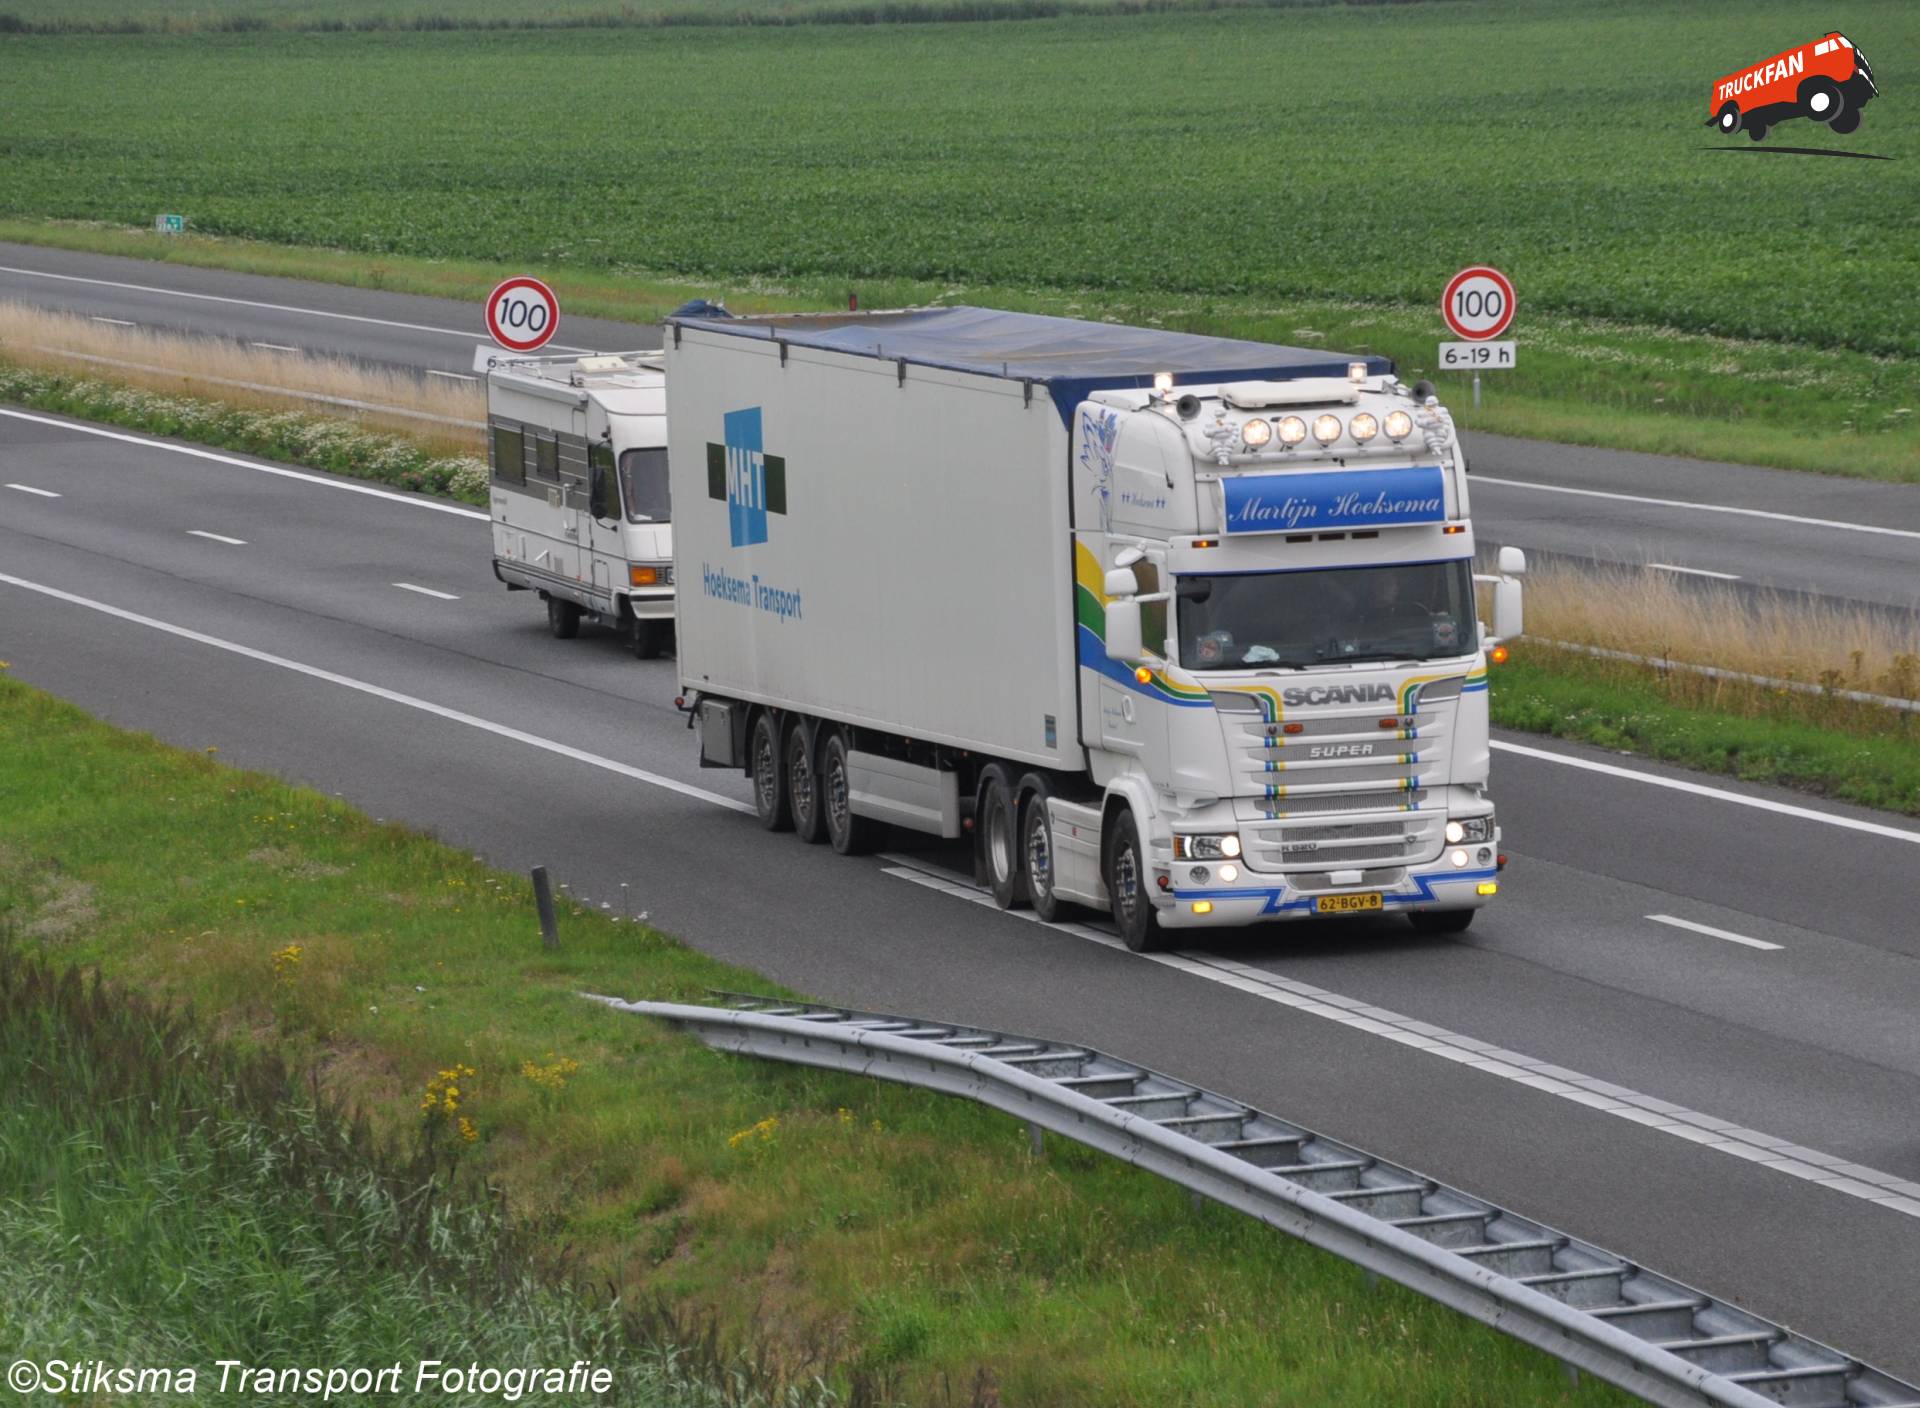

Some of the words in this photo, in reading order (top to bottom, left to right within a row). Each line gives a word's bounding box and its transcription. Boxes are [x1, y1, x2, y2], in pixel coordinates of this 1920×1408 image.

[501, 297, 546, 332] 100
[1456, 290, 1502, 318] 100
[1445, 347, 1490, 364] 6-19
[1499, 347, 1510, 363] h
[725, 445, 765, 510] MHT
[1327, 490, 1441, 517] Hoeksema
[702, 561, 752, 607] Hoeksema
[752, 574, 802, 625] Transport
[1282, 682, 1396, 707] SCANIA
[1310, 744, 1373, 758] SUPER
[1320, 894, 1378, 911] 62-BGV-8
